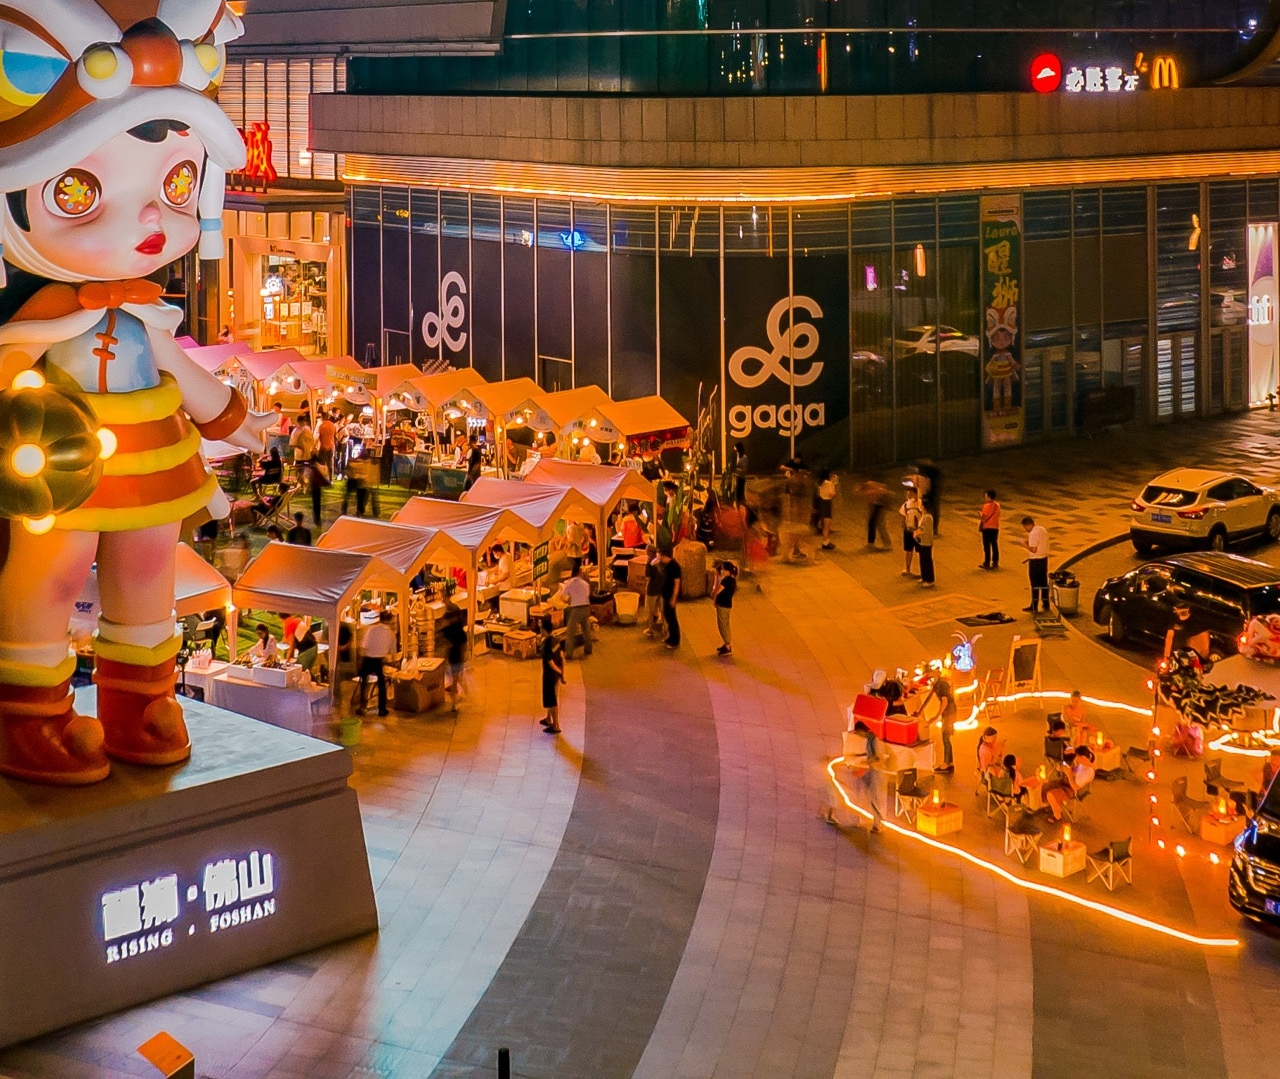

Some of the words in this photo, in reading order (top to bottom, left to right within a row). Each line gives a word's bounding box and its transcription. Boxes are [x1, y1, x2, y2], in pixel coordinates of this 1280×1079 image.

[729, 402, 825, 438] gaga
[106, 928, 173, 964] RISING
[210, 898, 276, 933] FOSHAN
